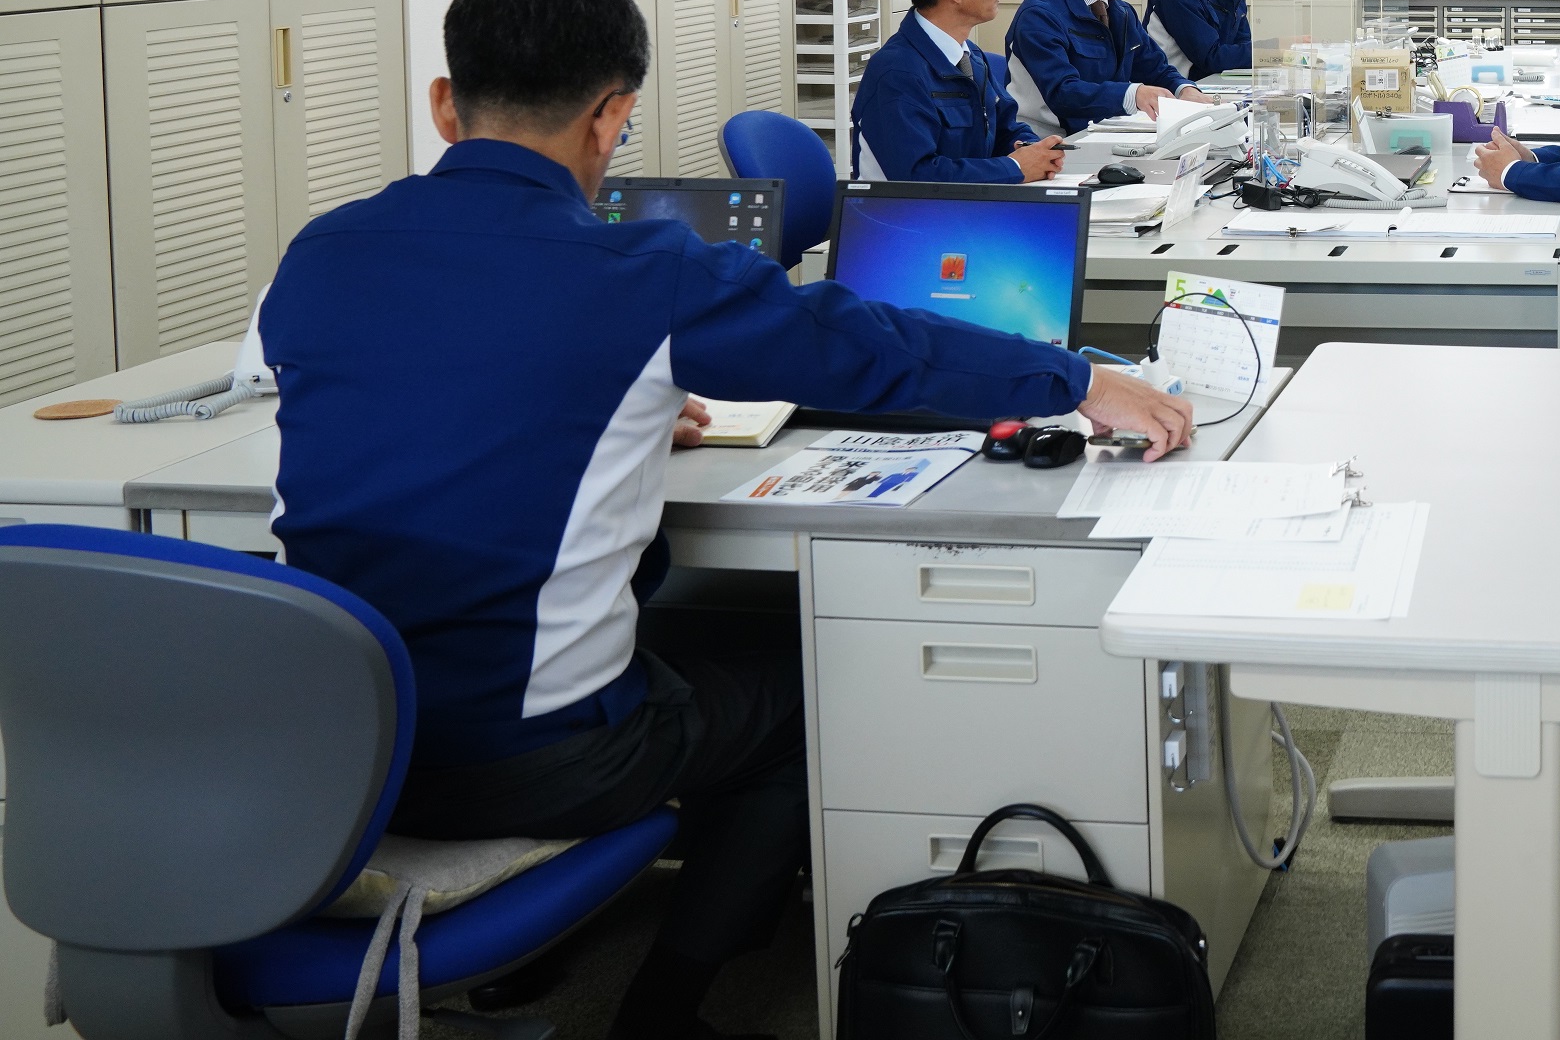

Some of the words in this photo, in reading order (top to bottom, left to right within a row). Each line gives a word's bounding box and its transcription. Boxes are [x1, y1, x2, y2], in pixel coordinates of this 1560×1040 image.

[1175, 278, 1187, 302] 5
[840, 432, 971, 446] 山陰経済
